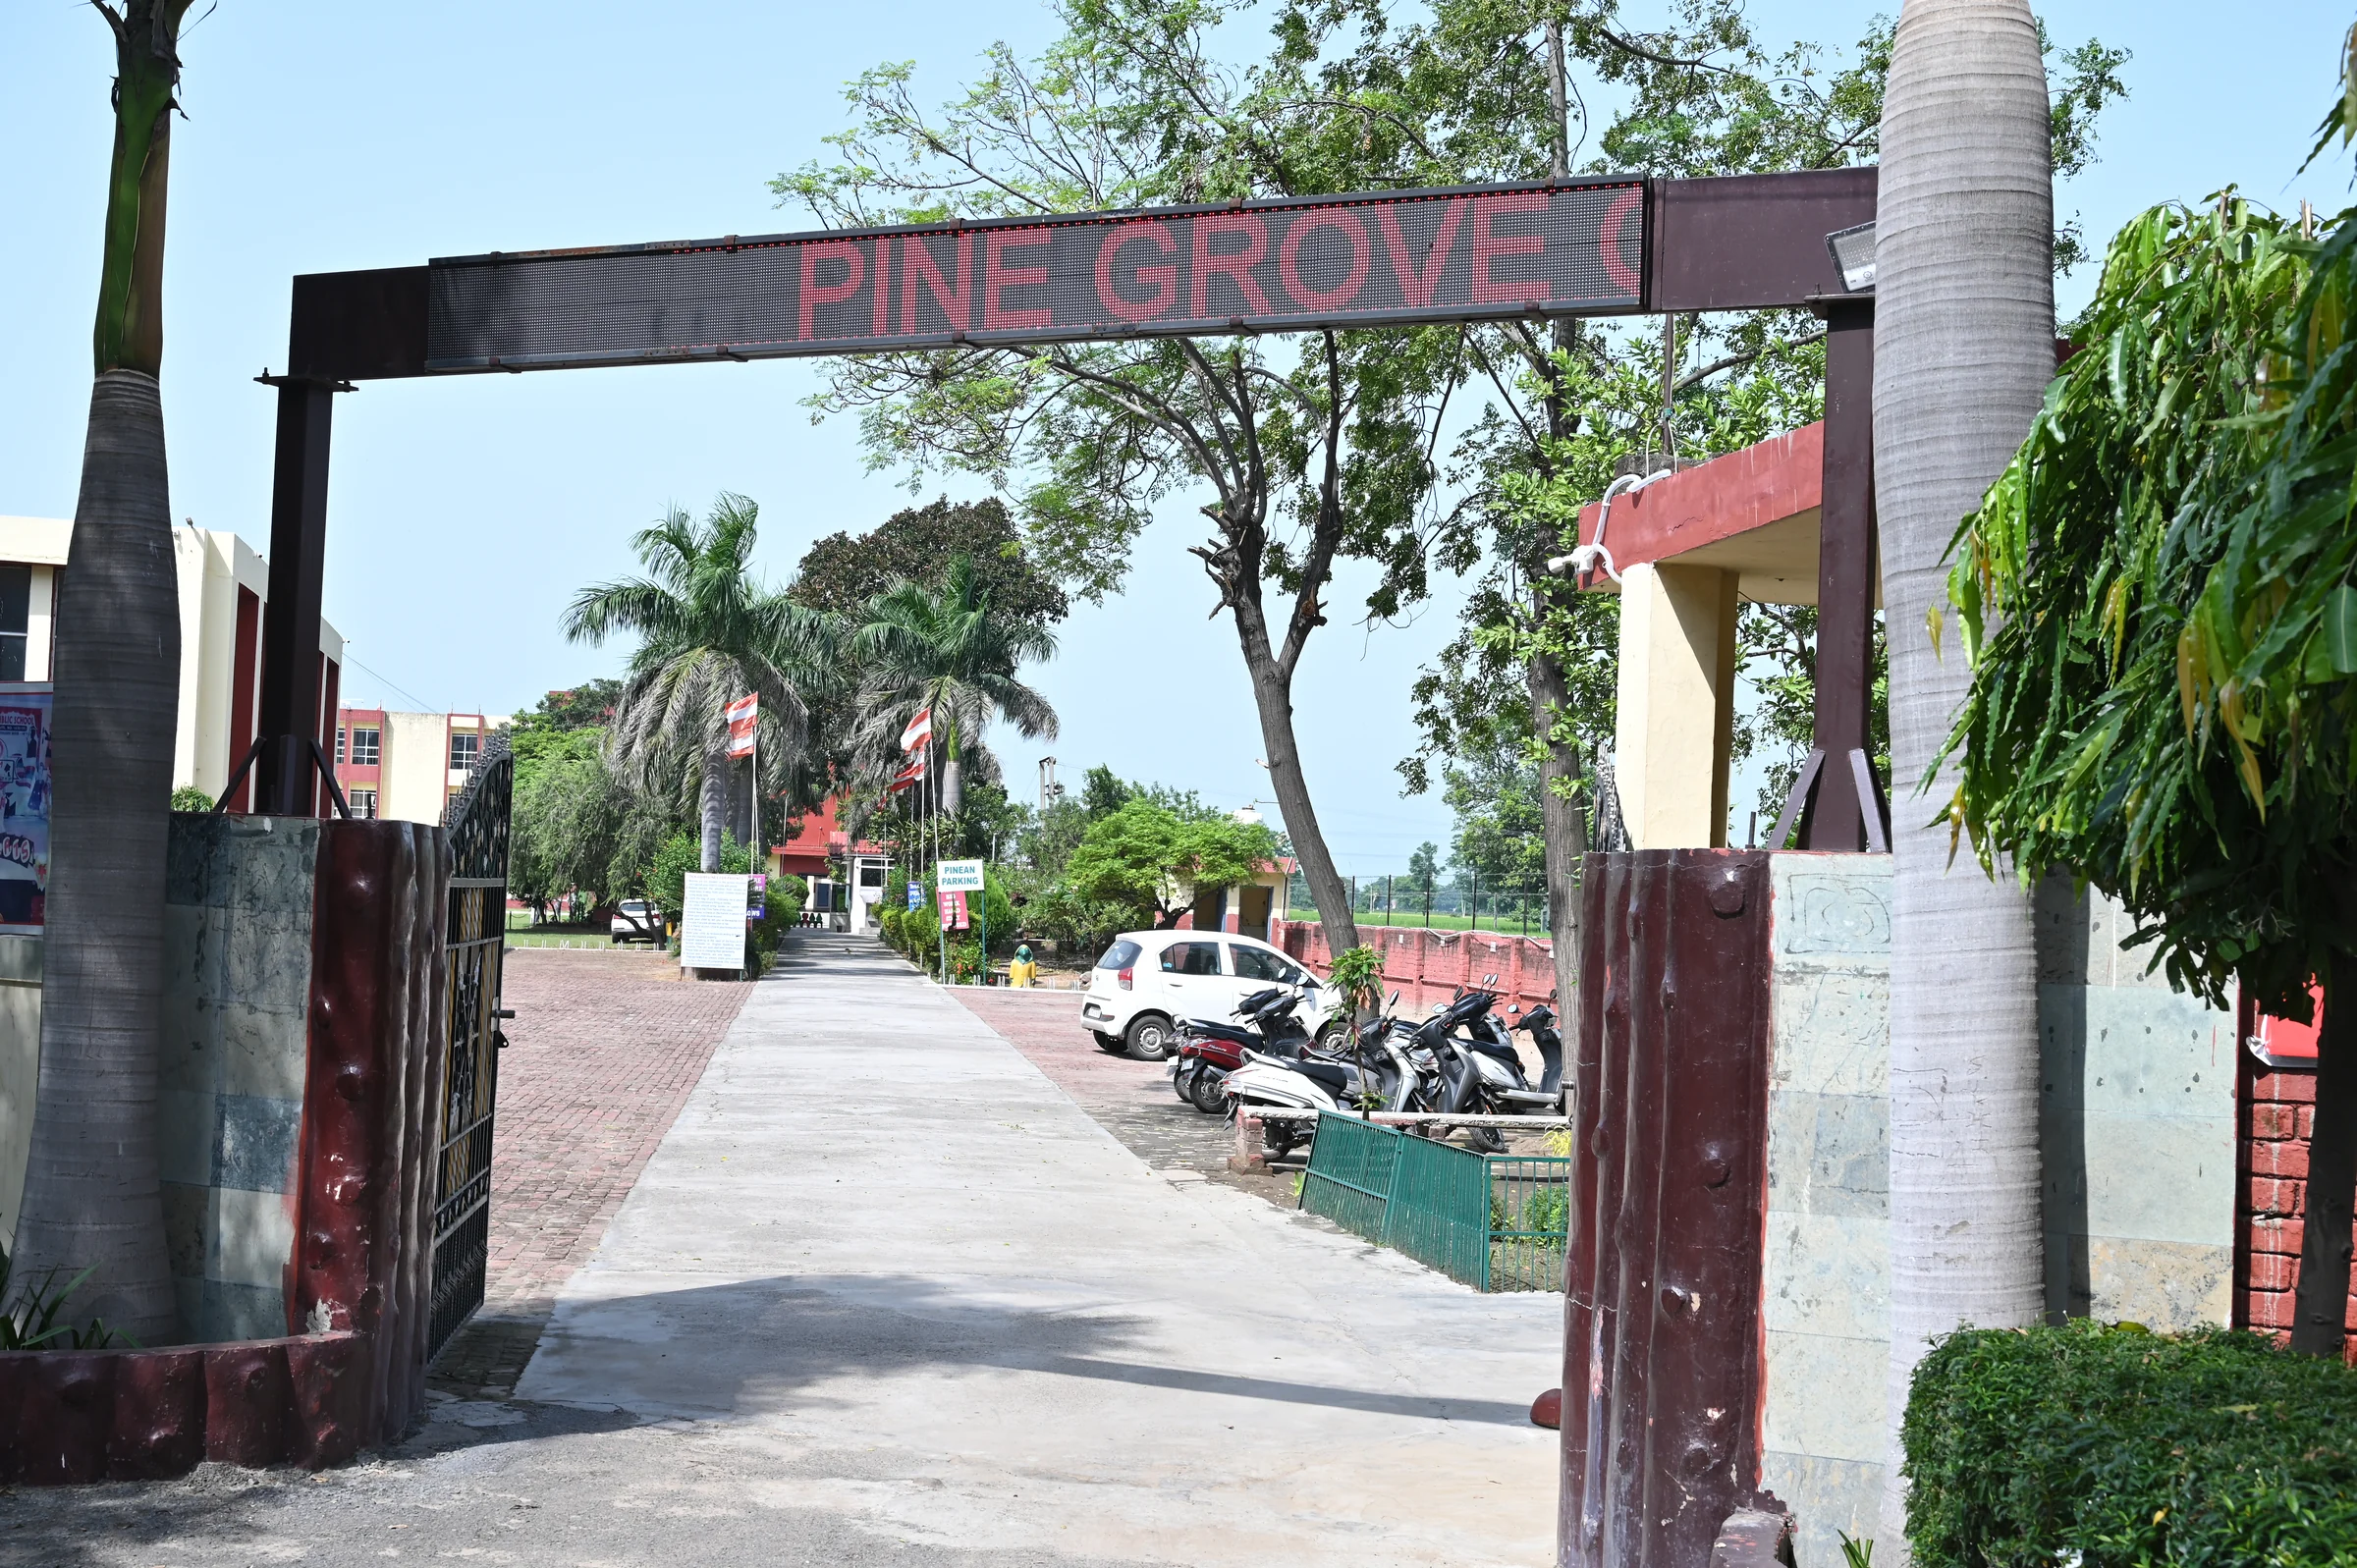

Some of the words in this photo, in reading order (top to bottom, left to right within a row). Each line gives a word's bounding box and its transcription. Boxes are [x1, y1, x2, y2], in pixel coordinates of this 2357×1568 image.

[797, 227, 1053, 342] PINE
[1093, 192, 1552, 323] GROVE
[942, 877, 979, 886] PARKING
